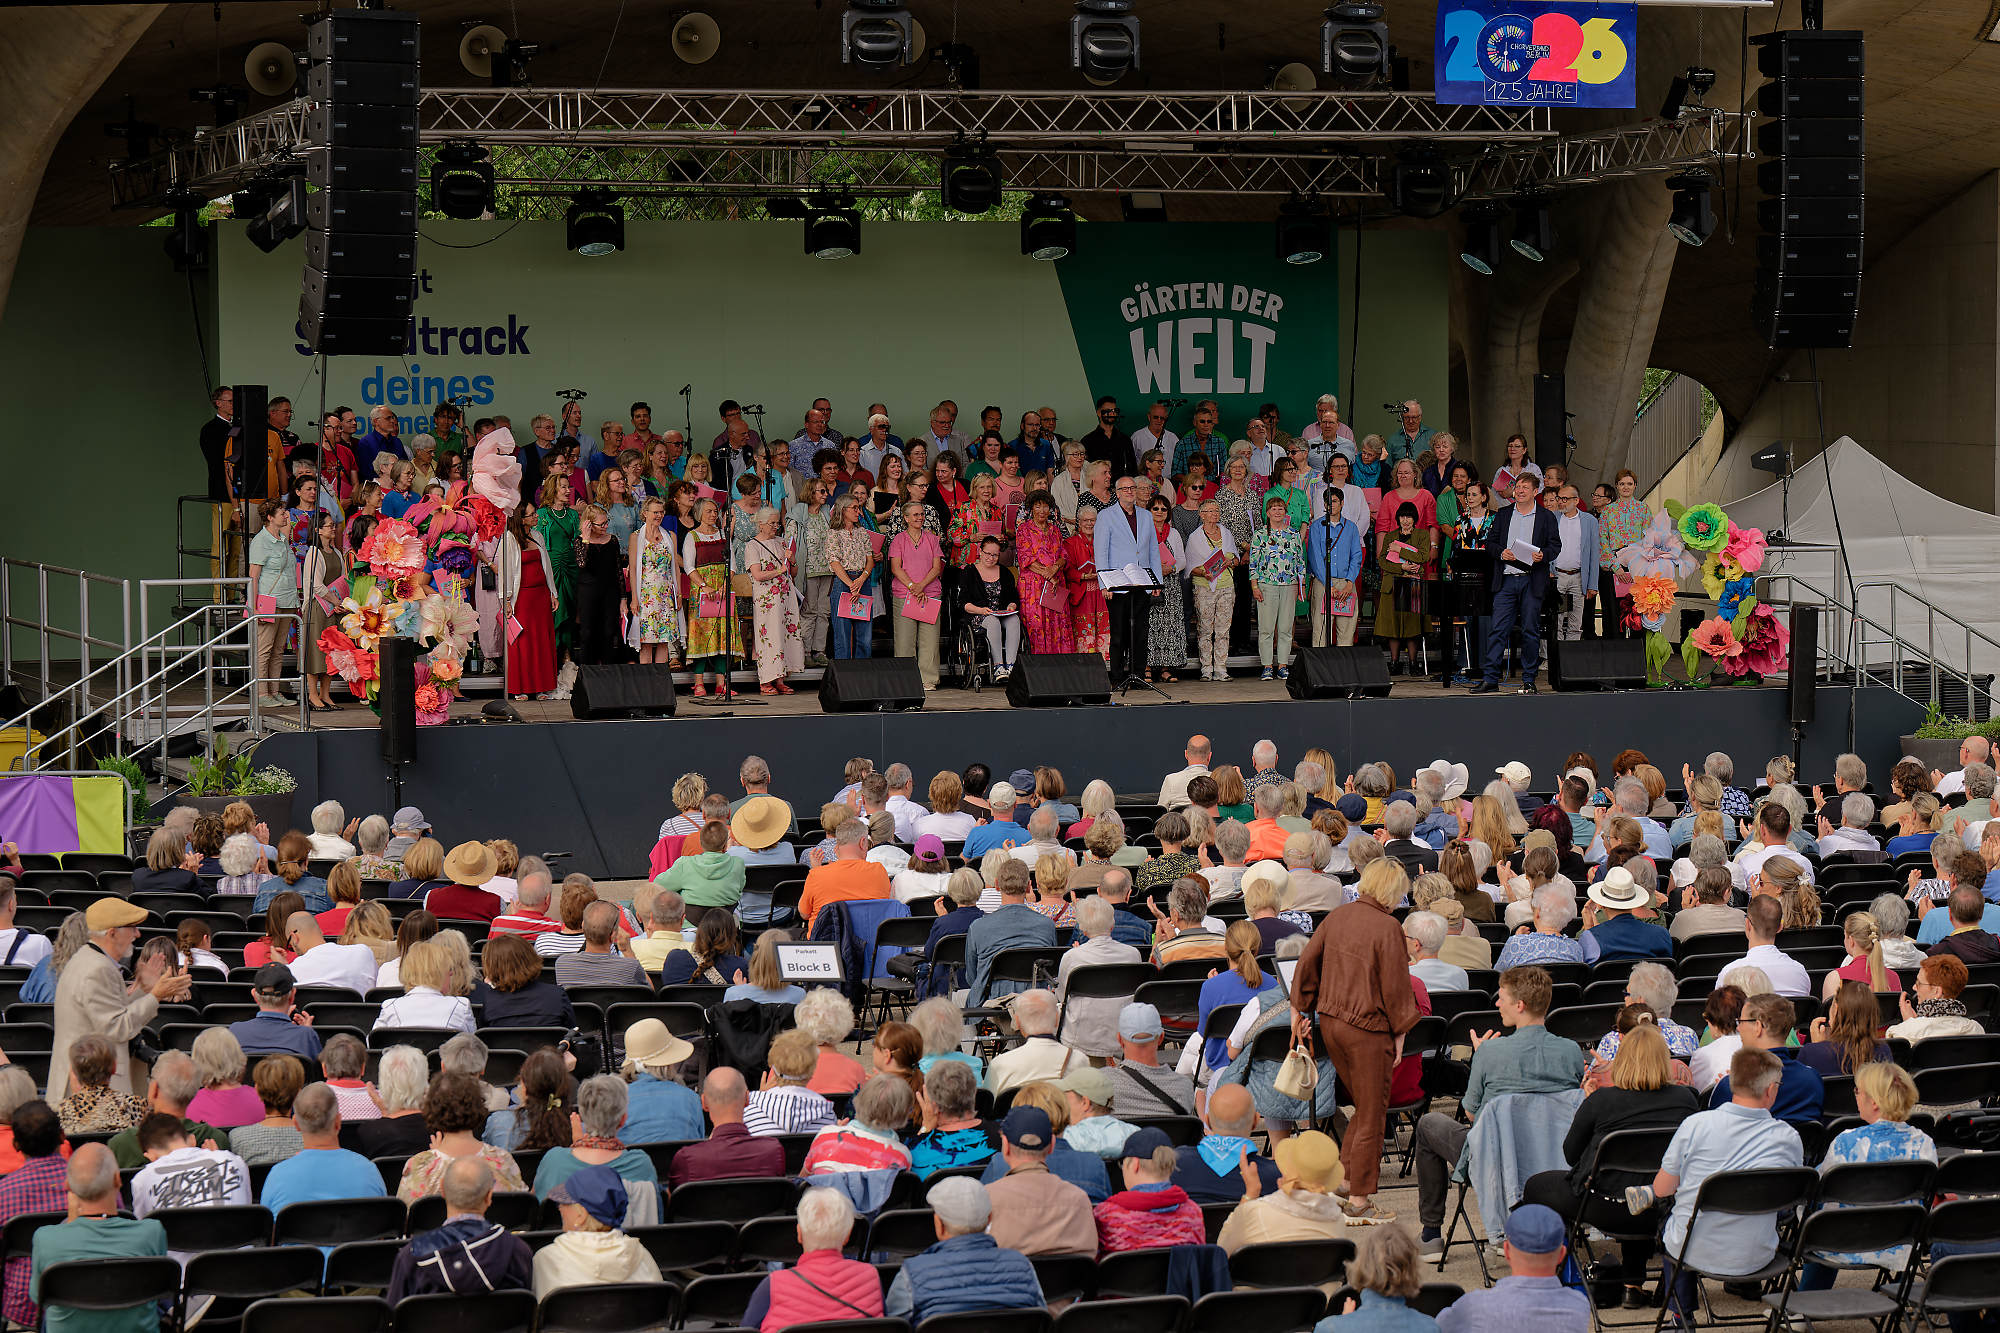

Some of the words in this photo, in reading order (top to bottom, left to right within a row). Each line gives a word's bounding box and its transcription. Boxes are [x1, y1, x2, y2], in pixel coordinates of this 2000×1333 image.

[1445, 10, 1627, 84] 2026
[1526, 83, 1574, 100] JAHRE
[1120, 281, 1224, 323] GÄRTEN
[1230, 284, 1284, 323] DER
[1129, 317, 1276, 394] WELT
[361, 364, 495, 405] deines
[787, 963, 820, 972] Block
[823, 963, 831, 972] B
